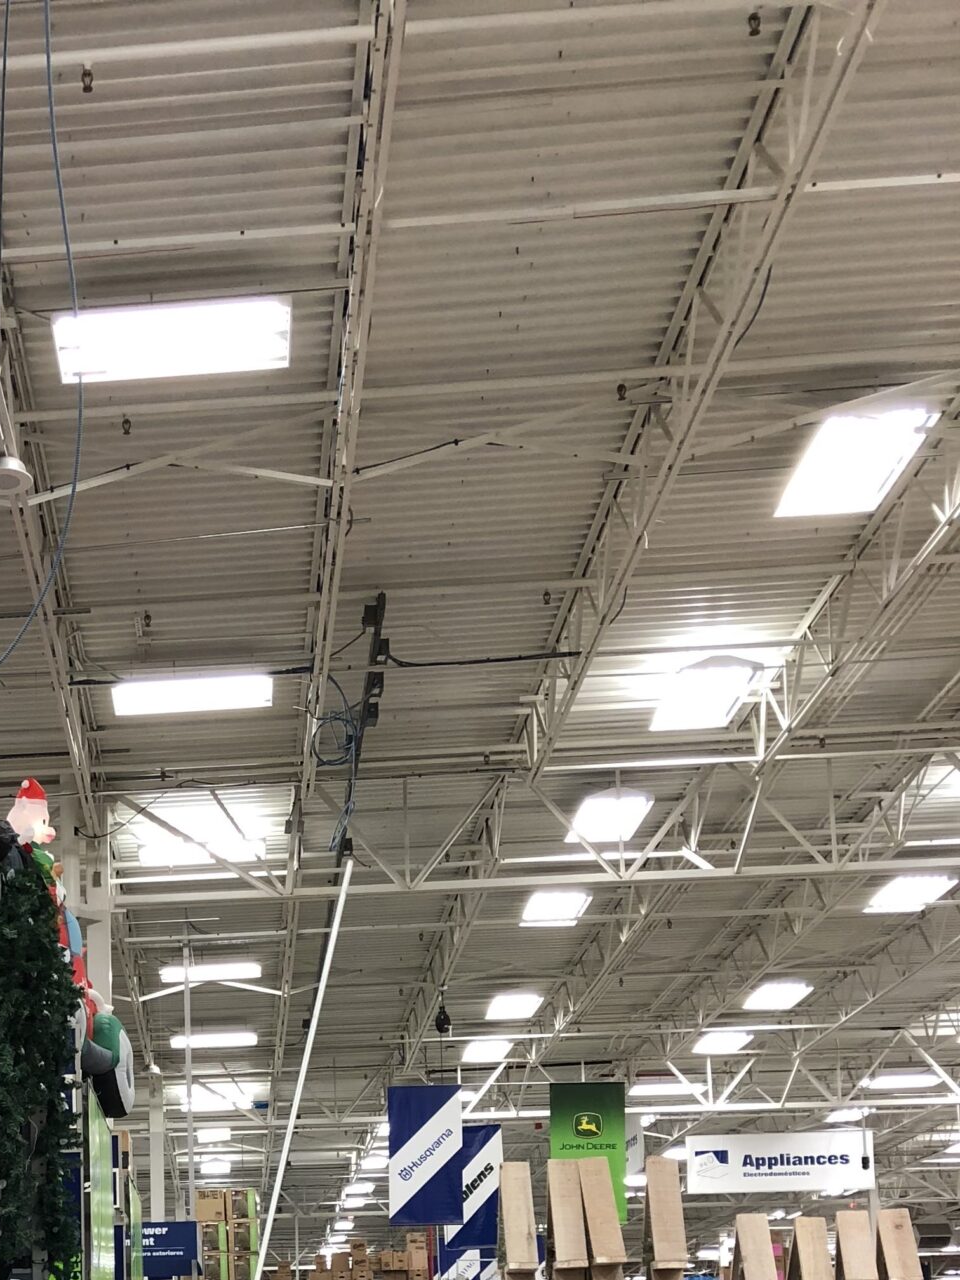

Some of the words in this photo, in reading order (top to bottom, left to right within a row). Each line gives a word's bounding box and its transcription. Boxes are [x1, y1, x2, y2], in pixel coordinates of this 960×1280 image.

[408, 1128, 454, 1173] Husqvarna
[559, 1142, 586, 1151] JOHN
[586, 1142, 618, 1151] DEERE
[742, 1154, 850, 1170] Appliances
[462, 1162, 495, 1203] olens
